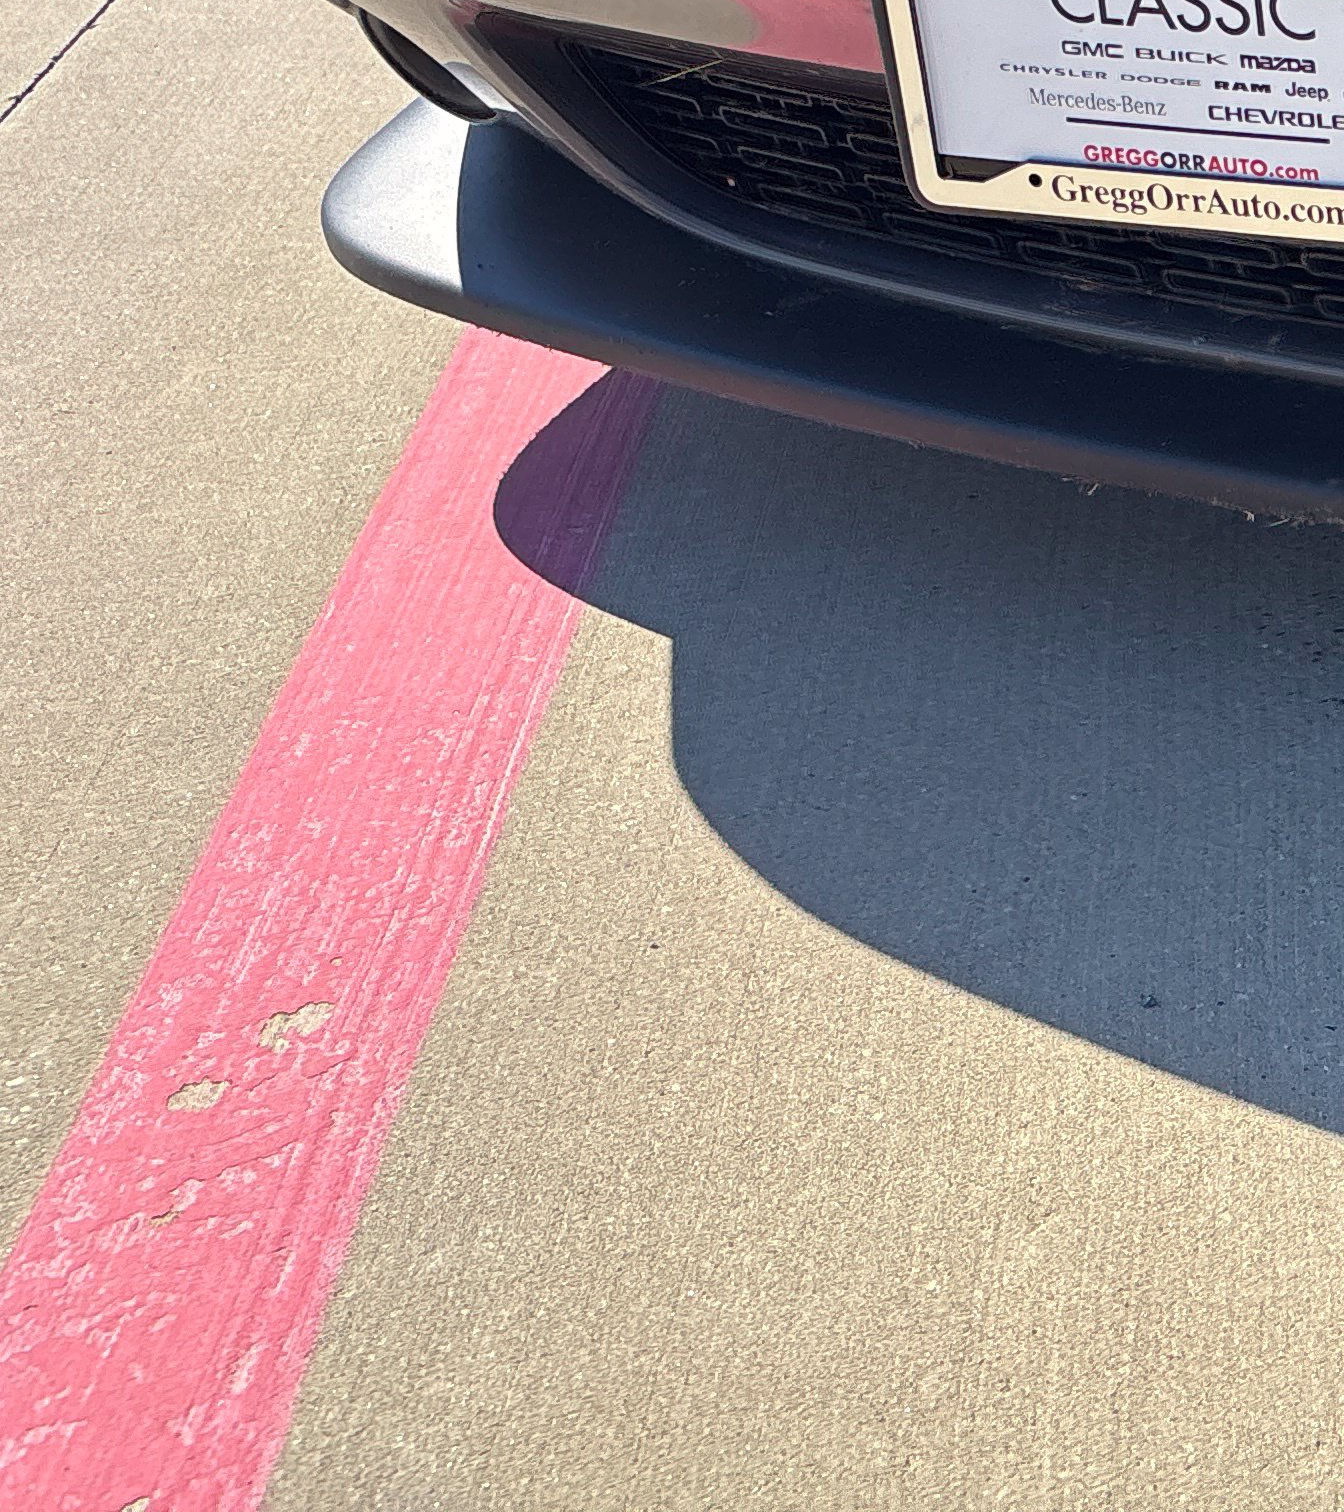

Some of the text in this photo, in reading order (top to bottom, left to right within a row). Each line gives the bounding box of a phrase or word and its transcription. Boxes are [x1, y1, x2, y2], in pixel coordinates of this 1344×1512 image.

[1061, 40, 1317, 75] GMC BUICK mazda
[1000, 63, 1108, 81] CHRYSLER
[1120, 73, 1202, 88] DODGE
[1214, 80, 1272, 95] RAM
[1285, 82, 1329, 102] Jeep
[1028, 88, 1168, 117] Mercedes-Benz
[1084, 144, 1320, 182] GREGGORRAUTO.com
